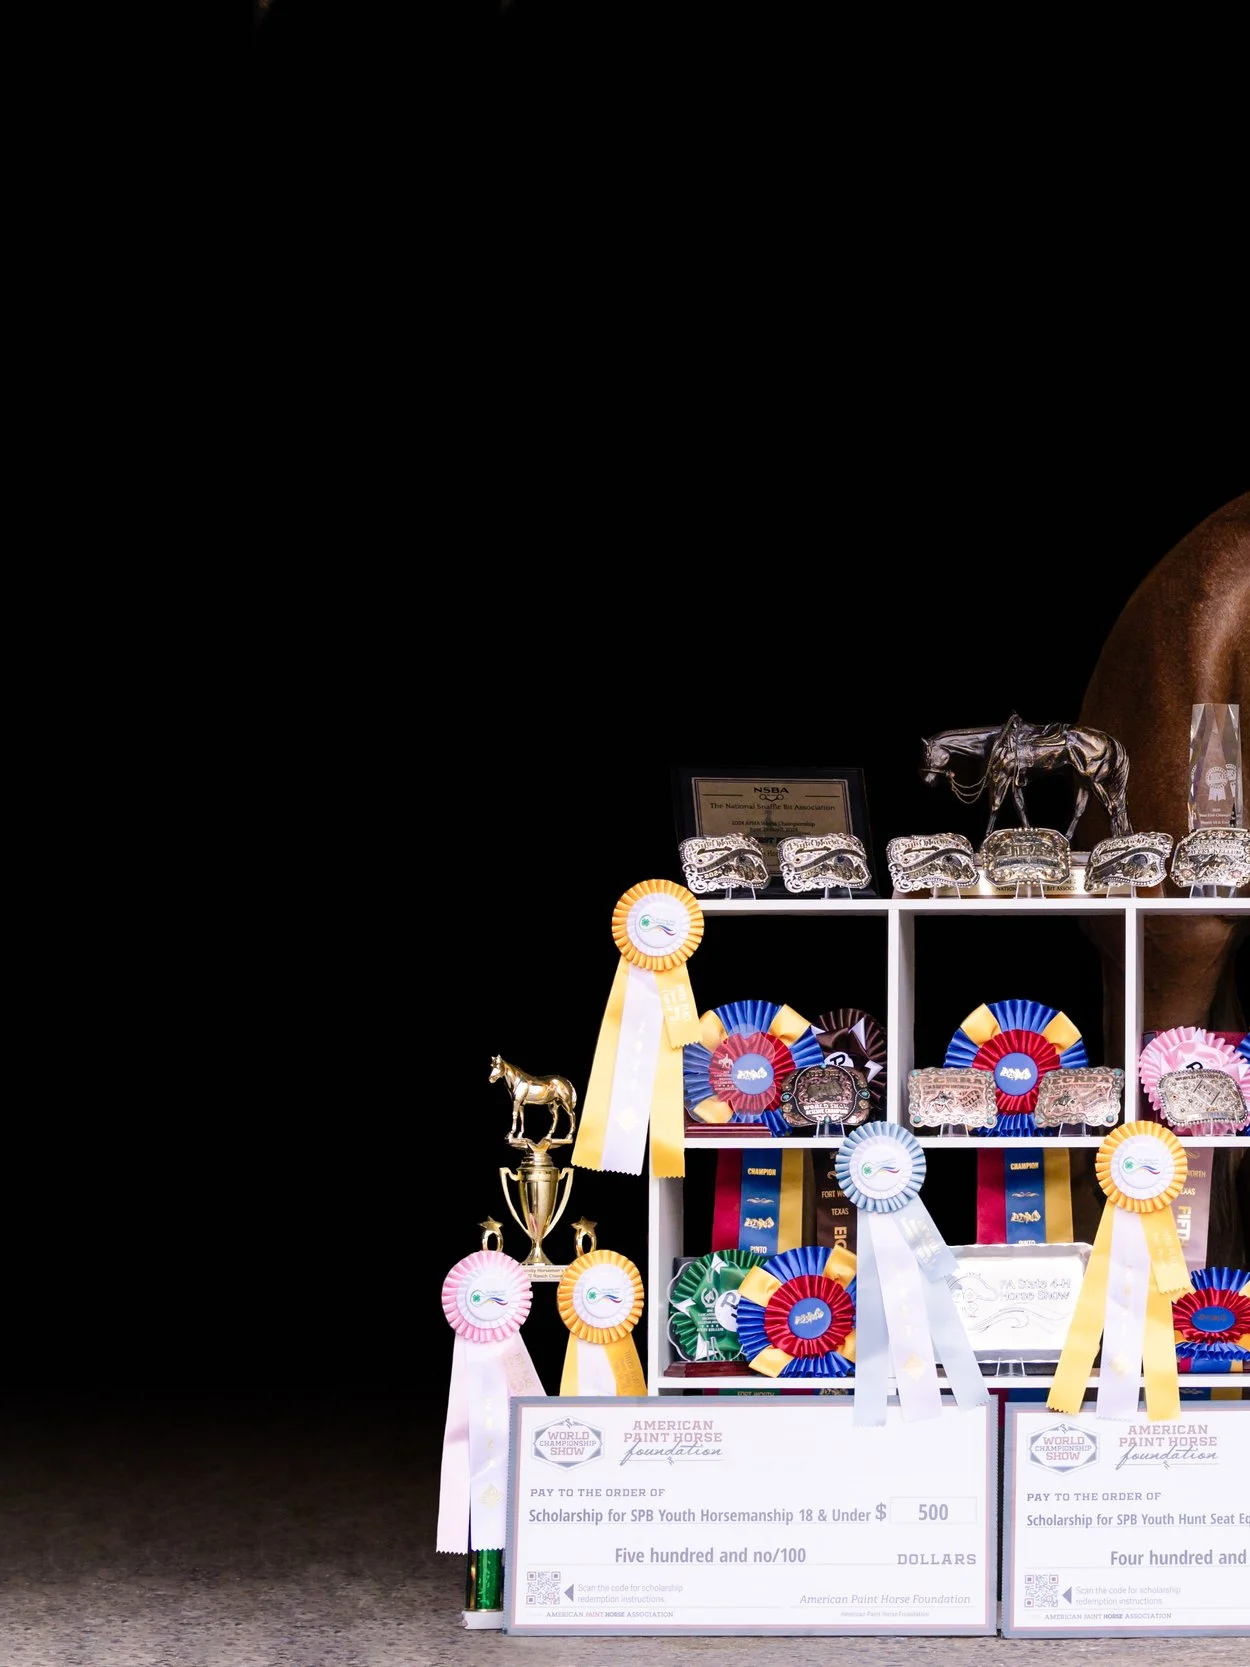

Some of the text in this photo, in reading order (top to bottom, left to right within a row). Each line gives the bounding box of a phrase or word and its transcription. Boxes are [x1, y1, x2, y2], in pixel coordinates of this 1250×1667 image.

[1010, 1162, 1039, 1171] CHAMPION
[747, 1167, 776, 1177] CHAMPION
[821, 1190, 835, 1198] FORT
[831, 1208, 849, 1216] TEXAS
[750, 1245, 767, 1254] PINTO
[1017, 1278, 1048, 1290] State
[1050, 1278, 1072, 1289] 4-H
[1000, 1290, 1070, 1301] Horse Show
[632, 1420, 714, 1431] AMERICAN
[1127, 1424, 1209, 1435] AMERICAN
[547, 1431, 590, 1440] WORLD
[623, 1432, 723, 1443] PAINT HORSE
[1043, 1436, 1085, 1445] WORLD
[1118, 1436, 1218, 1447] PAINT HORSE
[550, 1447, 585, 1456] SHOW
[620, 1438, 723, 1466] foundation
[1046, 1452, 1081, 1461] SHOW
[1115, 1443, 1219, 1471] foundation
[530, 1488, 666, 1497] PAY TO THE ORDER OF
[1027, 1492, 1161, 1502] PAY TO THE ORDER OF
[528, 1508, 871, 1526] Scholarship for SPB Youth Horsemanship 18 & Under
[875, 1502, 949, 1522] $ 500
[1026, 1514, 1093, 1529] Scholarship
[1096, 1513, 1113, 1525] for
[1116, 1513, 1137, 1525] SPB
[1141, 1513, 1175, 1525] Youth
[1178, 1513, 1207, 1525] Hunt
[1210, 1512, 1235, 1525] Seat
[614, 1547, 807, 1564] Five hundred and no/100
[897, 1553, 977, 1565] DOLLARS
[1110, 1550, 1144, 1566] Four
[1149, 1549, 1213, 1565] hundred
[1218, 1549, 1246, 1565] and
[577, 1583, 684, 1593] Scan the code for scholarship
[1075, 1586, 1181, 1596] Scan the code for scholarship
[577, 1594, 619, 1604] redemption
[799, 1594, 971, 1604] American Paint Horse Foundation
[1075, 1597, 1118, 1607] redemption
